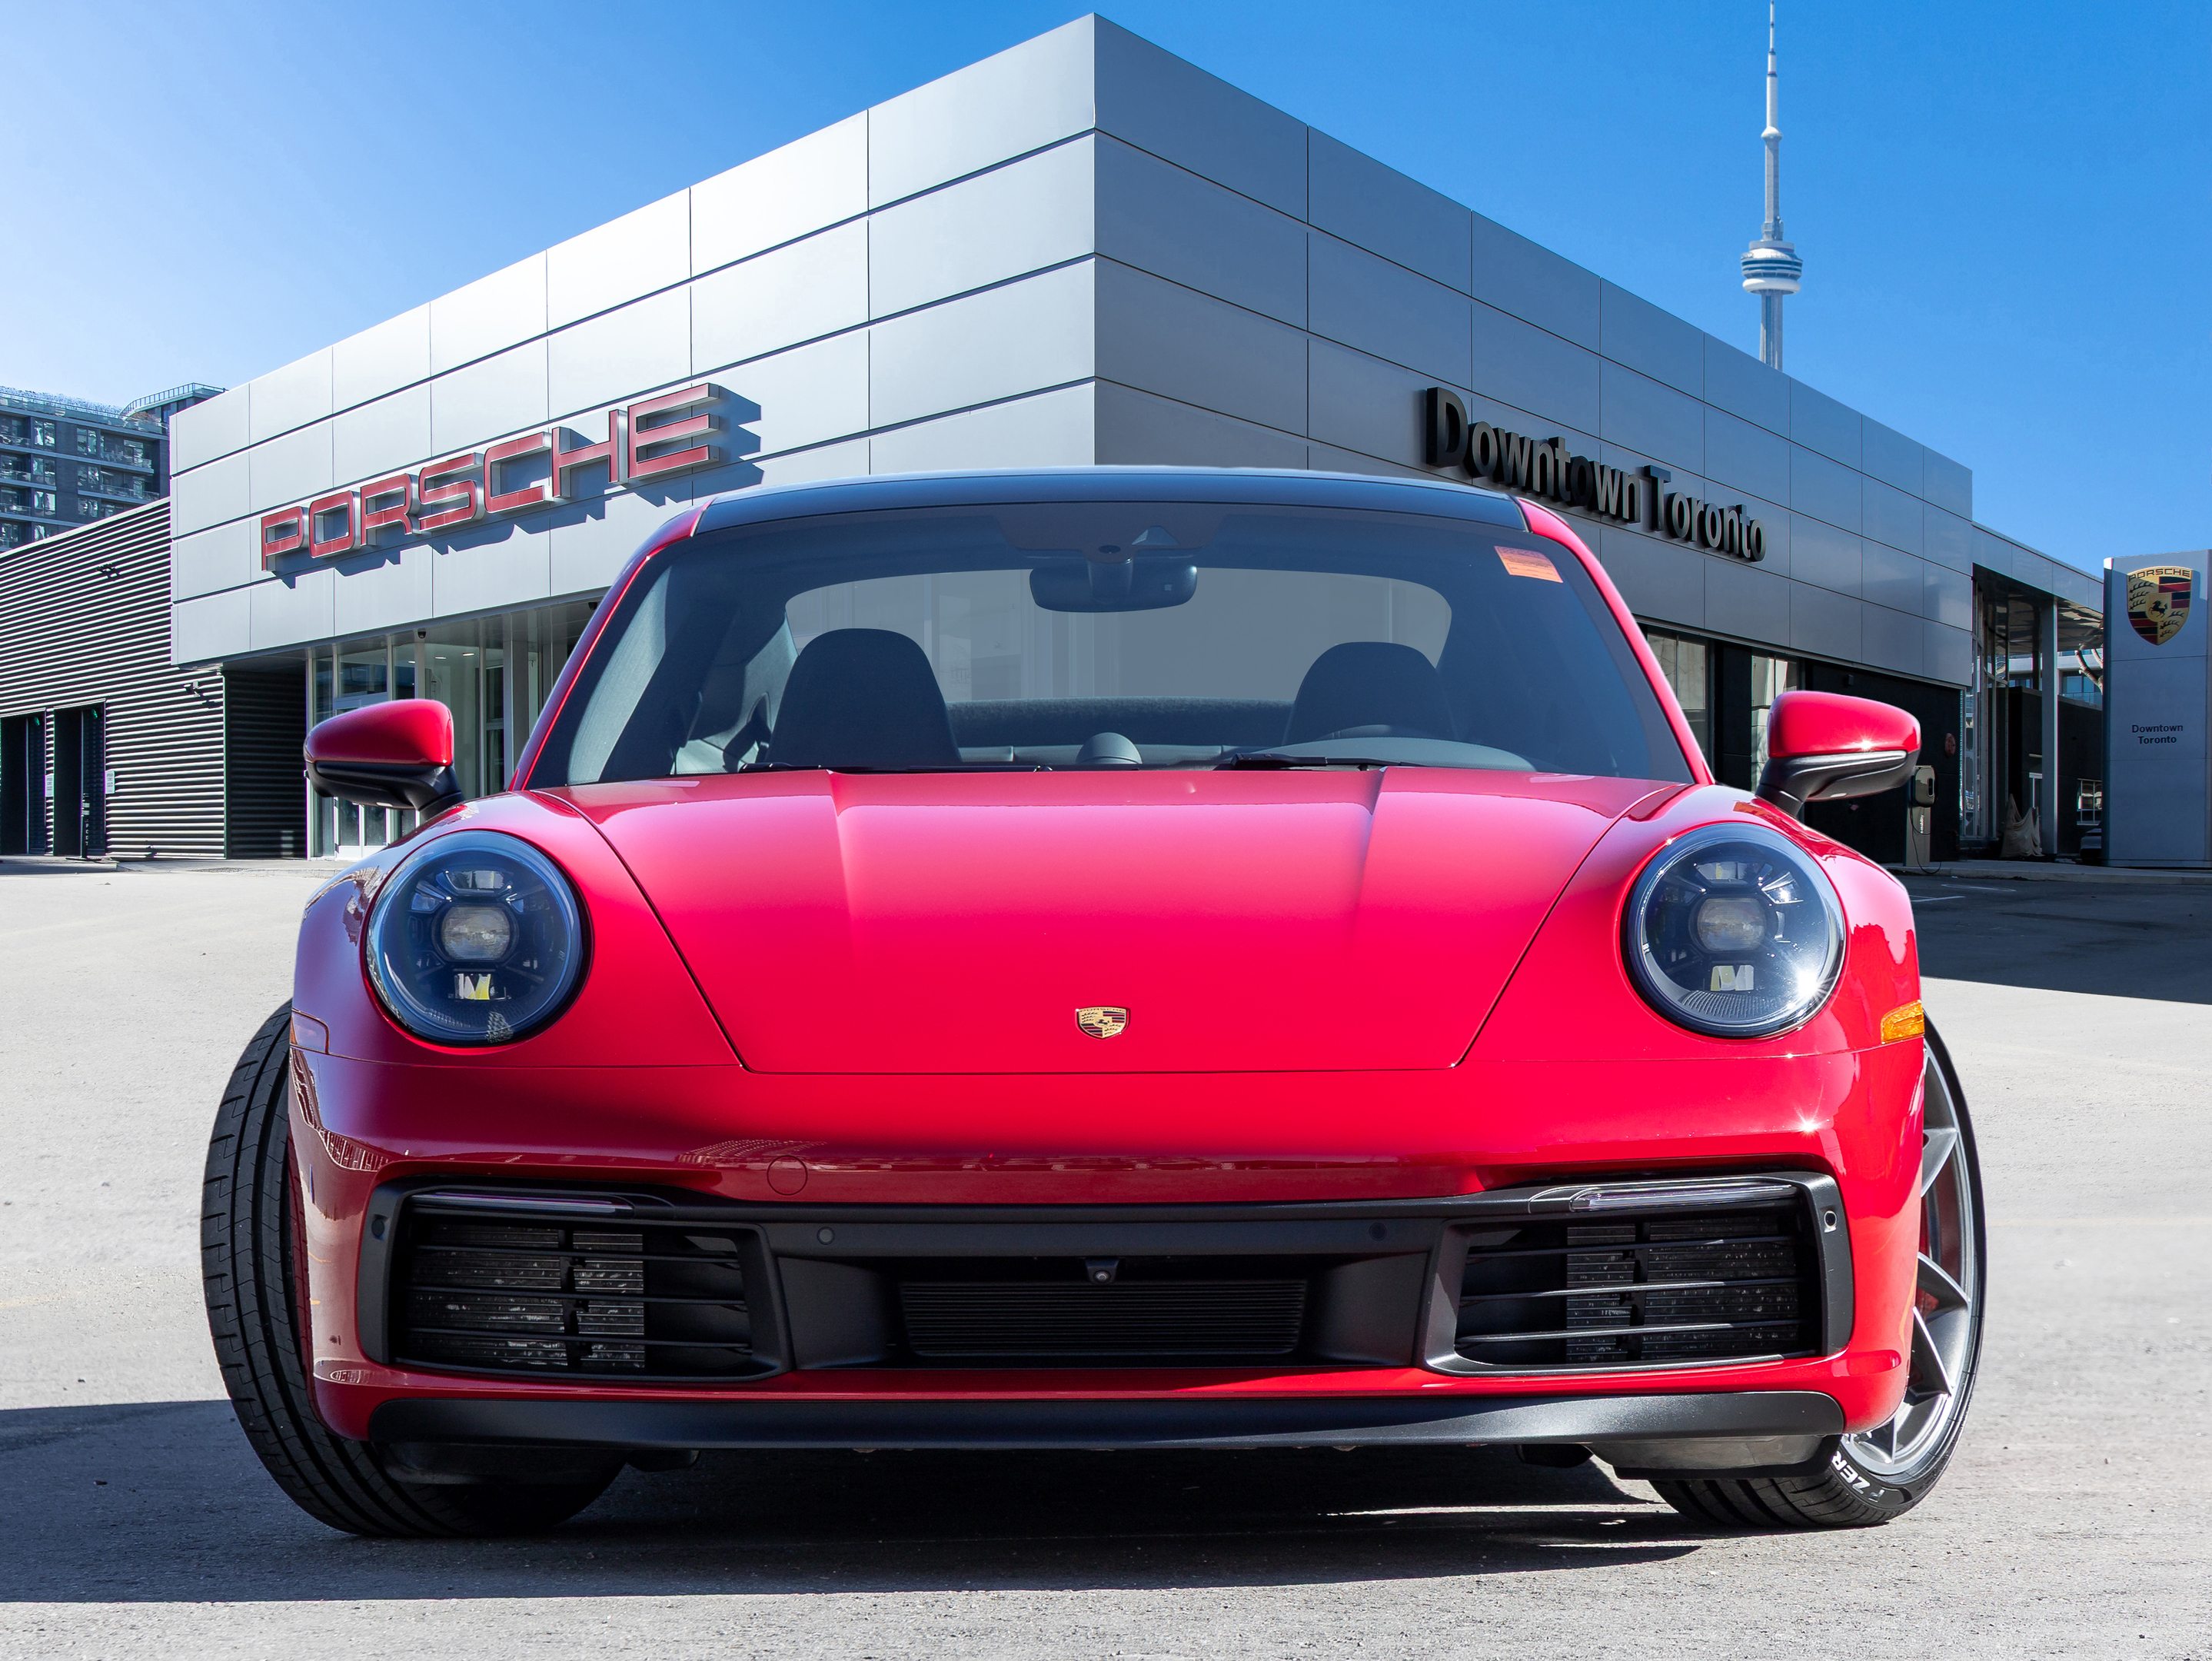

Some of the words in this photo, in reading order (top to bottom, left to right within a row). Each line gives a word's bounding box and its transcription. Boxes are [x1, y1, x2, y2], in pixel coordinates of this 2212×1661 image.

[261, 383, 720, 571] PORSCHE
[1425, 386, 1641, 524] Downtown
[1644, 464, 1767, 562] Toronto
[2128, 568, 2191, 582] PORSCHE
[2131, 724, 2184, 734] Downtown
[2137, 735, 2177, 744] Toronto
